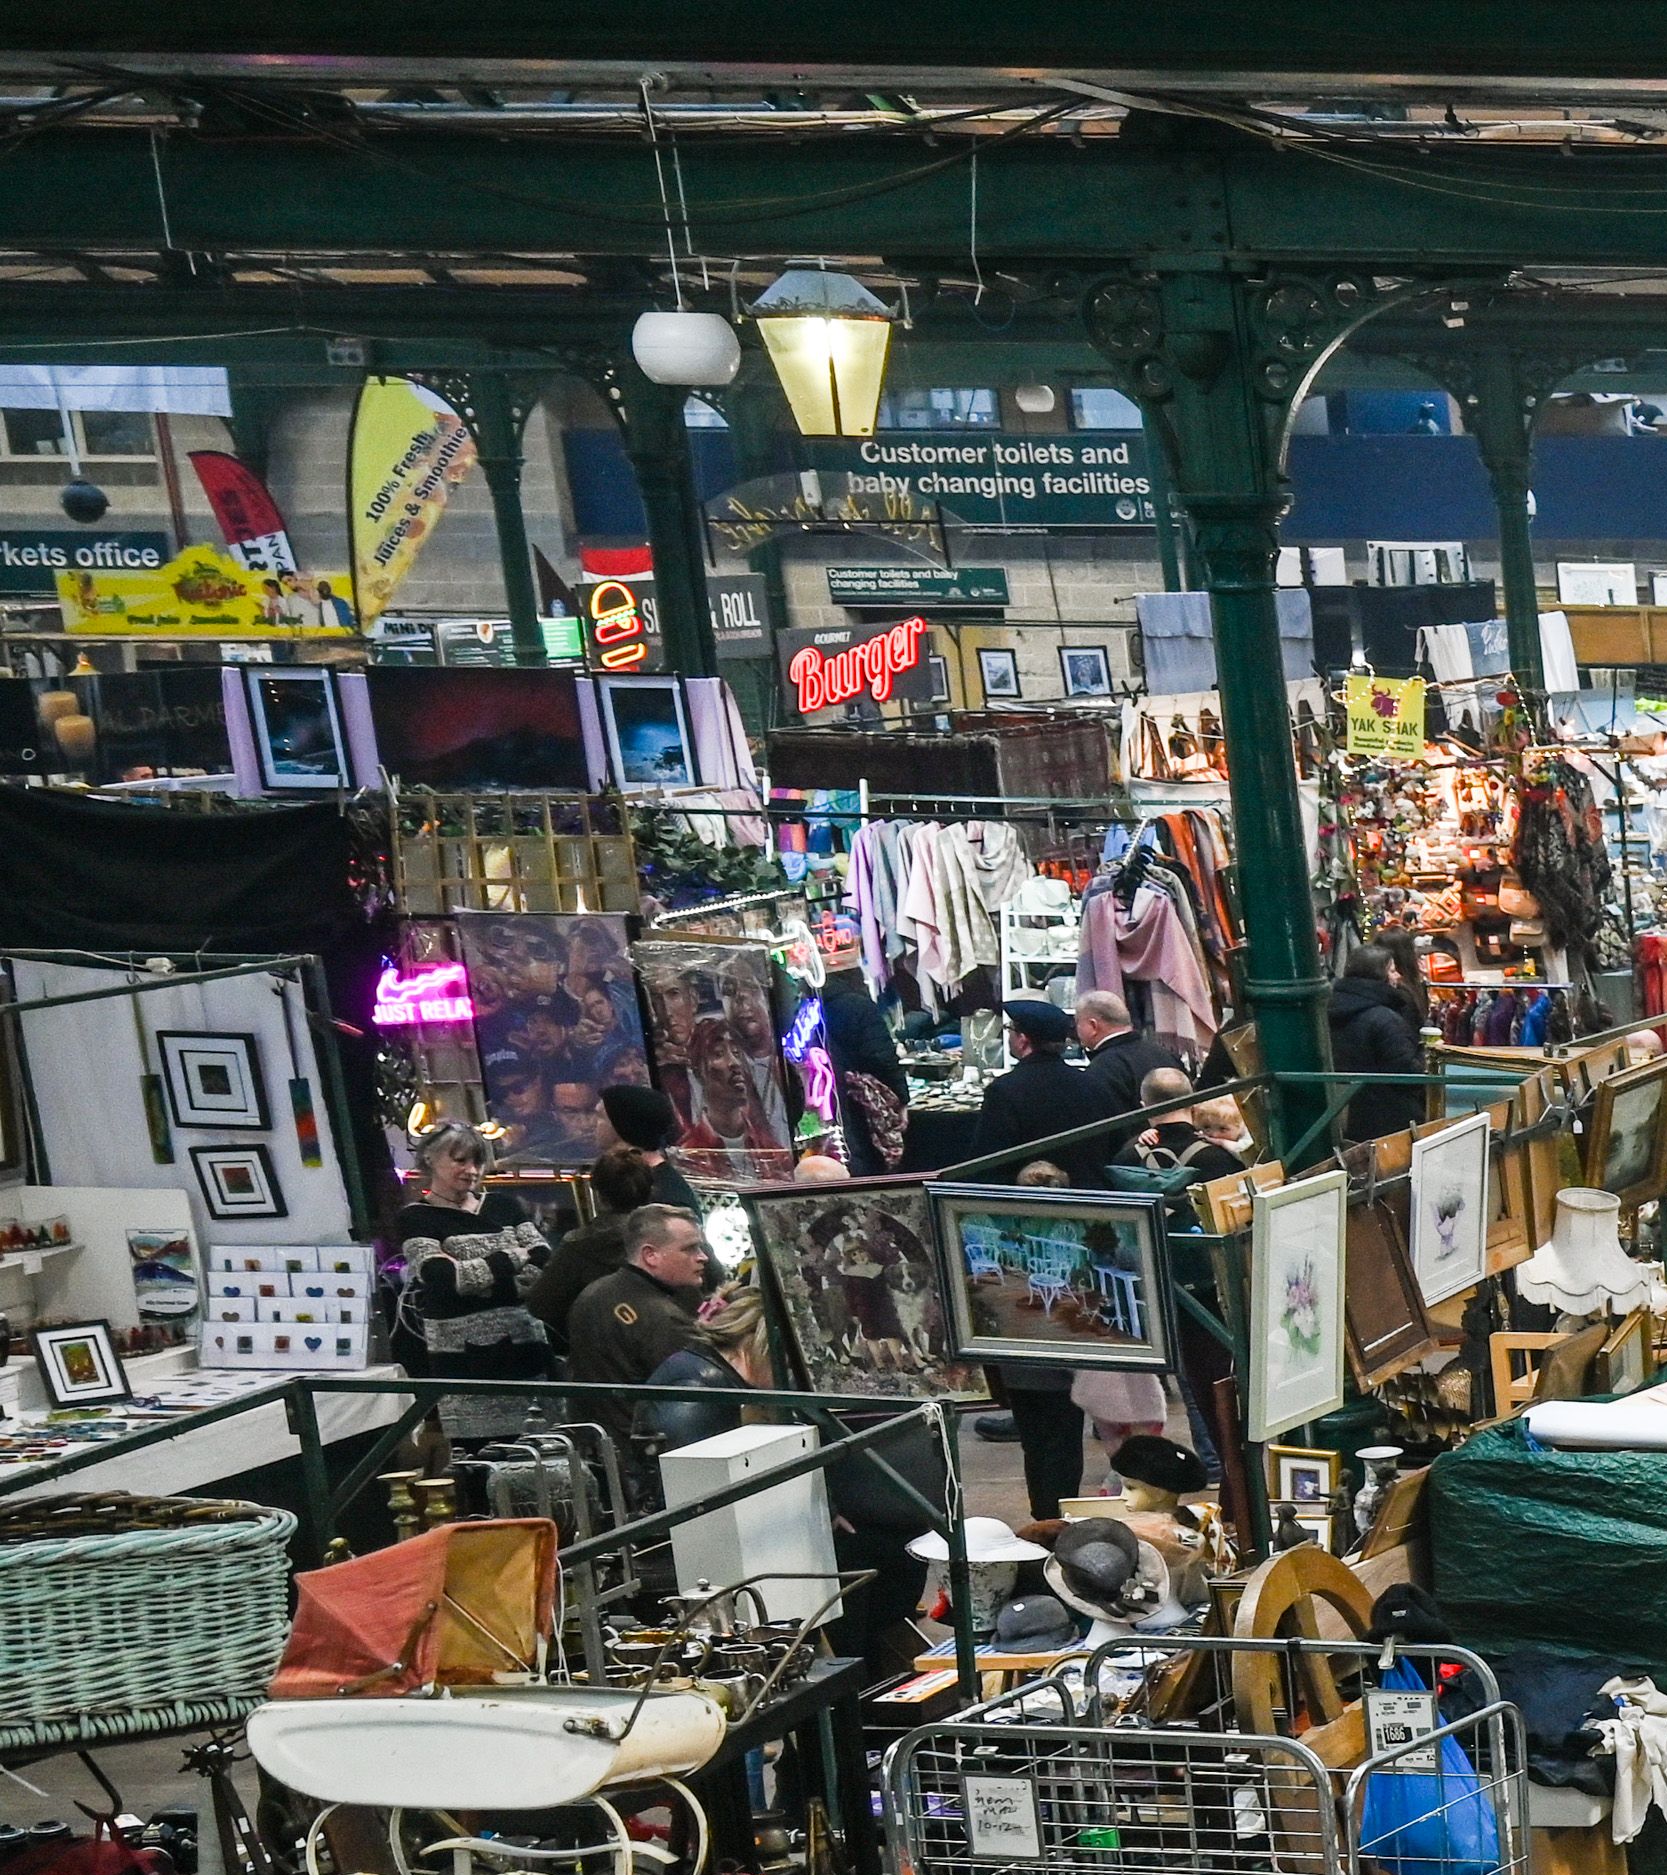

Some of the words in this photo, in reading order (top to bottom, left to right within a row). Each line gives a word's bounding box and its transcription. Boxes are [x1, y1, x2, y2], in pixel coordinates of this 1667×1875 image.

[860, 441, 987, 465] Customer
[994, 442, 1074, 465] toilets
[1080, 443, 1130, 465] and
[365, 480, 401, 524] 100%
[392, 429, 435, 479] Fresh
[847, 471, 910, 496] baby
[918, 471, 1037, 500] changing
[1041, 472, 1151, 496] facilities
[373, 517, 412, 567] Juices
[405, 502, 422, 516] &
[414, 426, 470, 500] Smoothie
[76, 541, 161, 568] office
[828, 569, 877, 579] Customer
[879, 569, 911, 579] toilets
[913, 569, 931, 579] and
[831, 579, 876, 591] changing
[878, 579, 919, 590] facilities
[722, 592, 761, 627] ROLL
[814, 631, 852, 645] GOURMET
[789, 616, 927, 714] Burger
[1351, 717, 1376, 732] YAK
[371, 1002, 416, 1025] JUST
[1384, 1726, 1406, 1742] 1686
